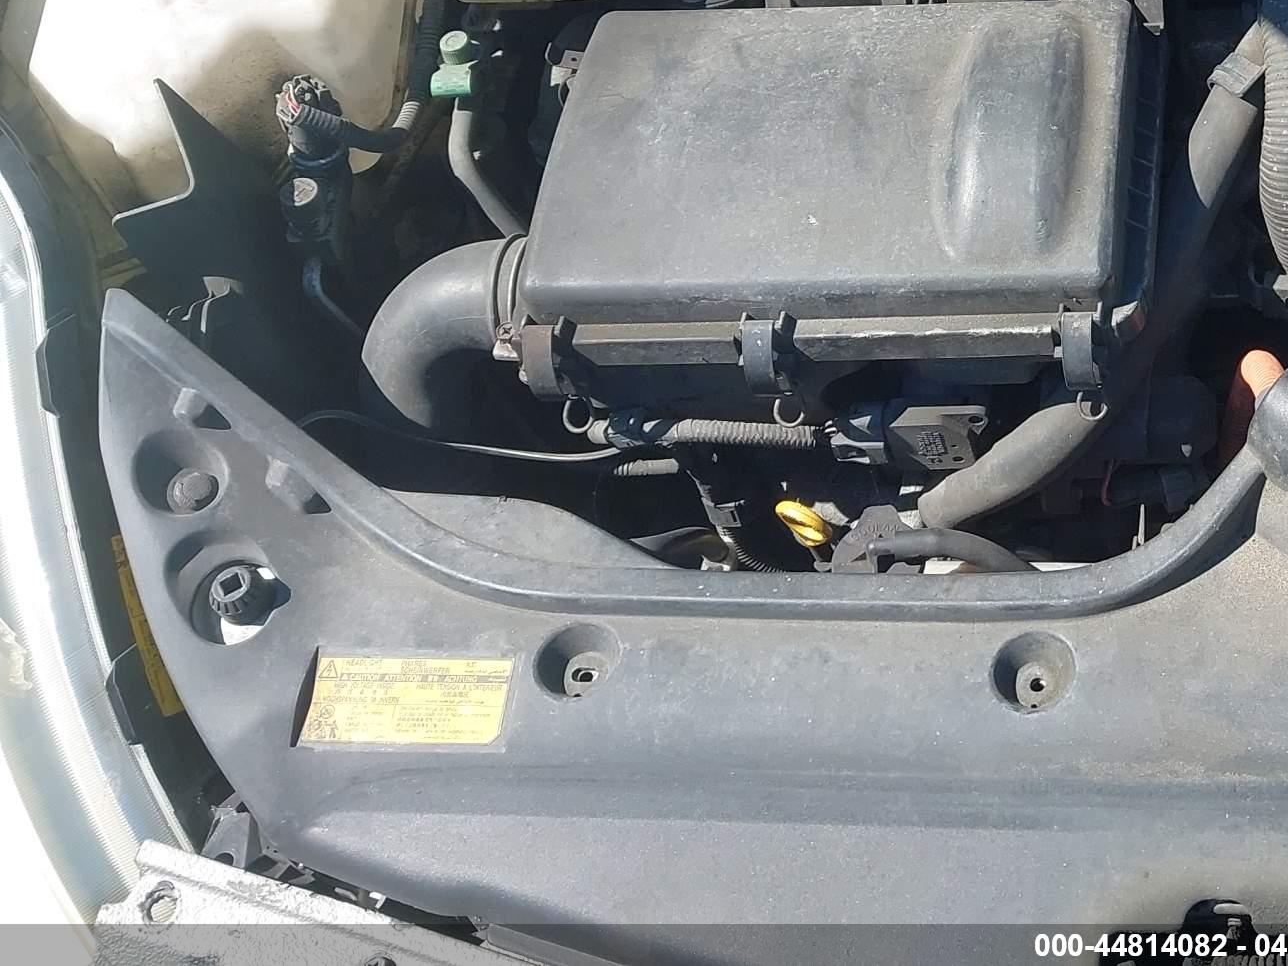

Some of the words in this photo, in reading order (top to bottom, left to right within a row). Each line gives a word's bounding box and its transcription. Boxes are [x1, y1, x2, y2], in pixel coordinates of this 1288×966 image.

[350, 674, 379, 682] CAUTION
[384, 674, 423, 682] ATTENTION
[444, 675, 478, 683] ACHTUNG
